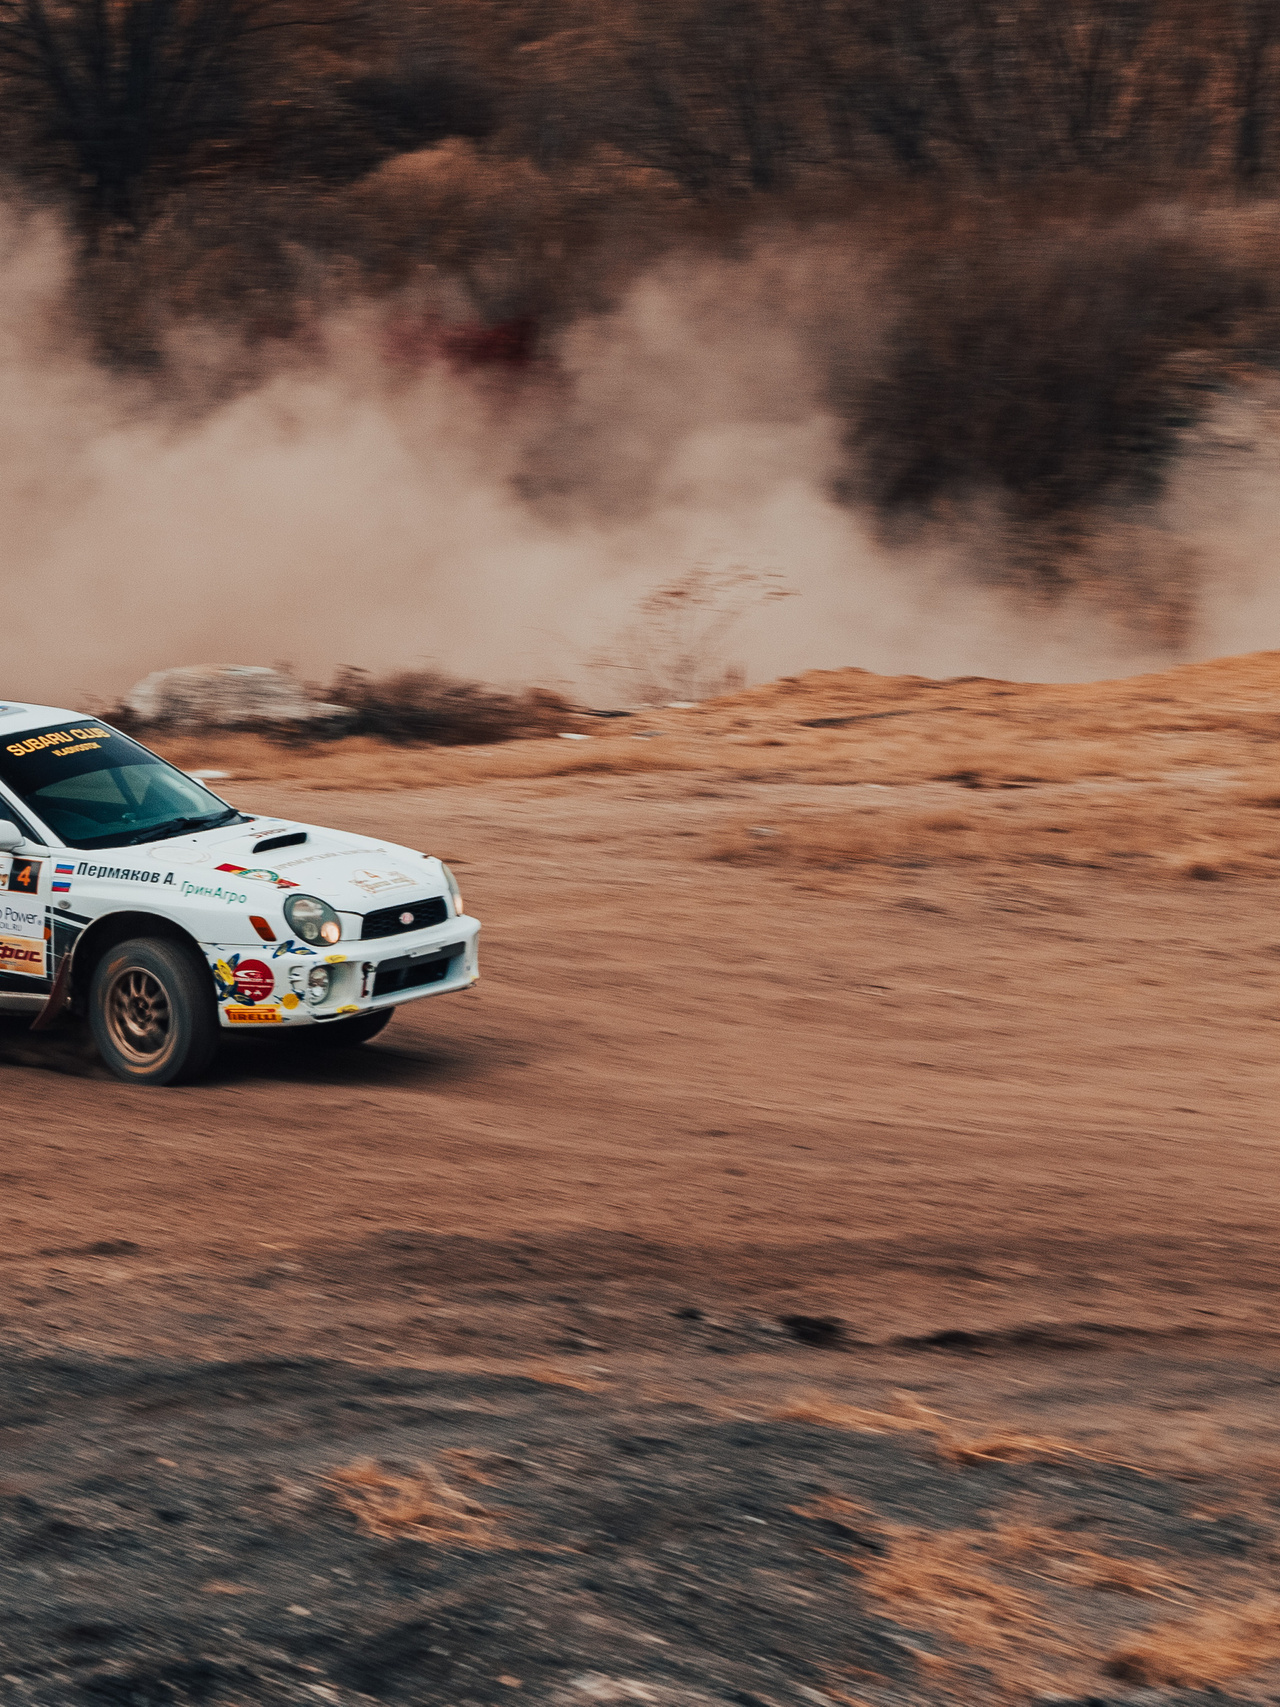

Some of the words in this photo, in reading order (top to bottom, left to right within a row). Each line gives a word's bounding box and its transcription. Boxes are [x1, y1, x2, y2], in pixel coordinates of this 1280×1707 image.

[6, 731, 74, 757] SUBARU
[70, 727, 111, 740] CLUB
[51, 742, 102, 757] VLADIVOSTOK
[17, 865, 32, 887] 4
[77, 861, 161, 884] Пермяков
[181, 880, 248, 905] ГринАгро
[5, 906, 38, 925] Power
